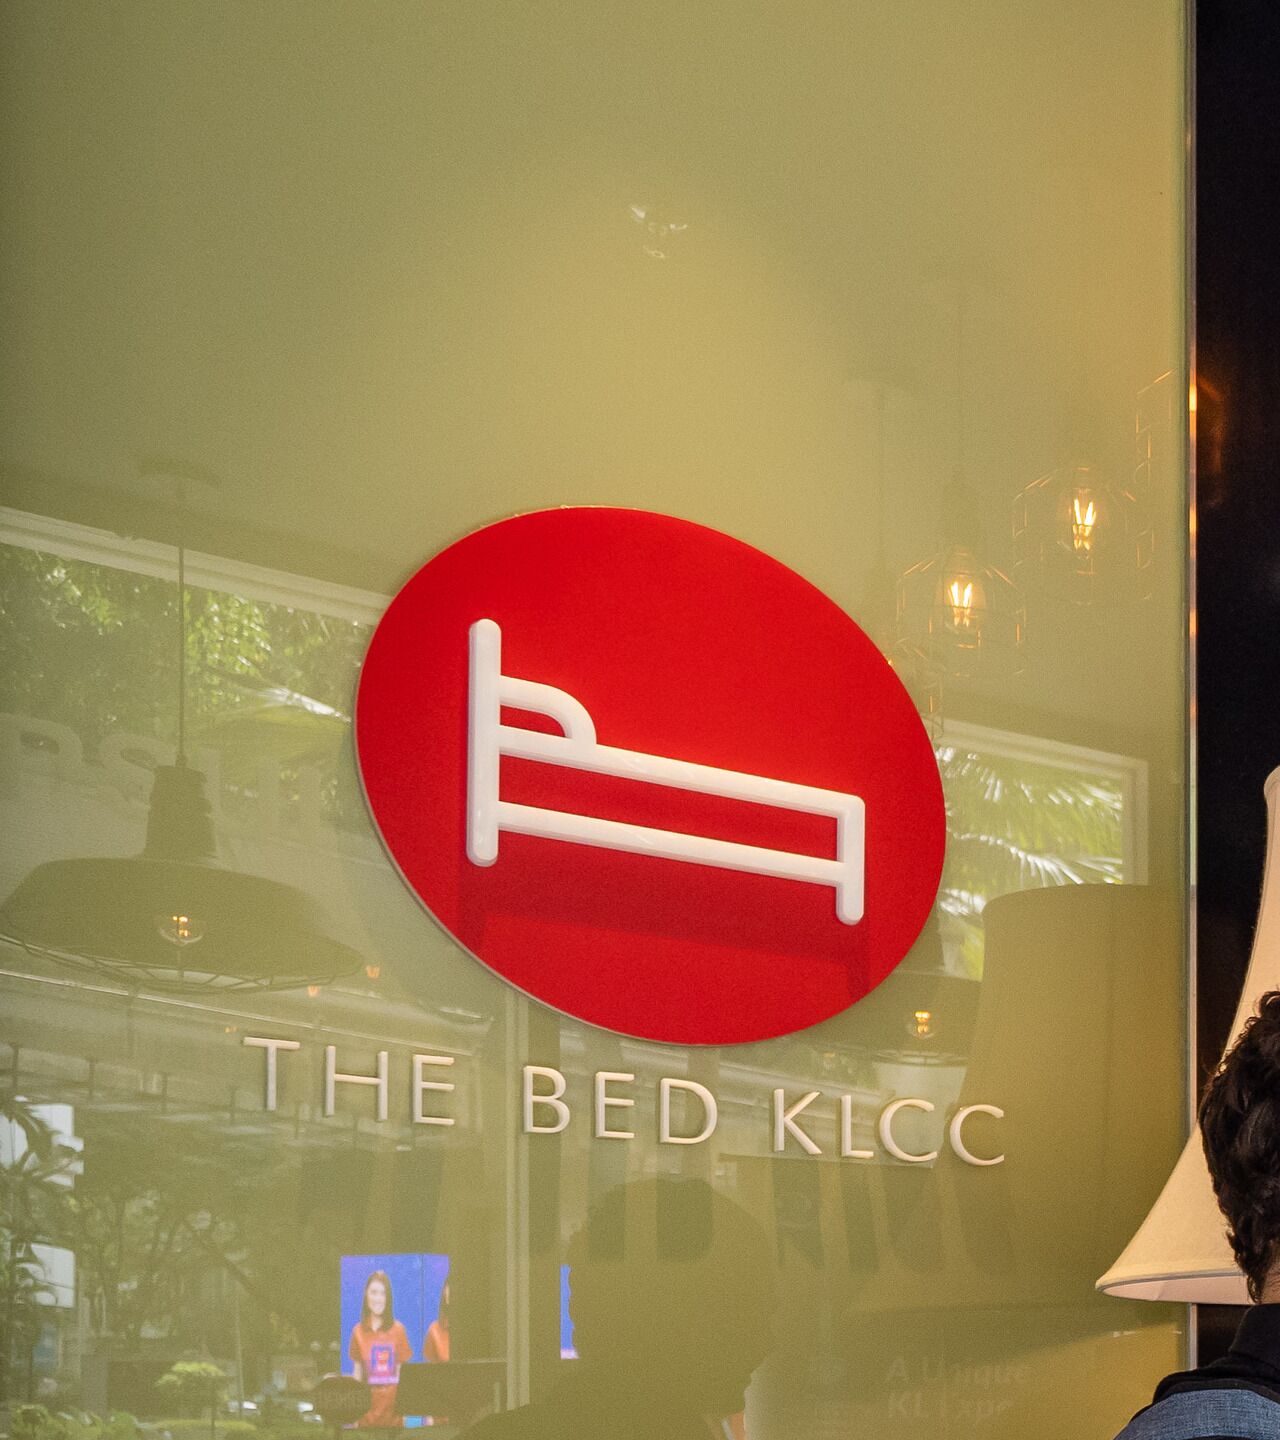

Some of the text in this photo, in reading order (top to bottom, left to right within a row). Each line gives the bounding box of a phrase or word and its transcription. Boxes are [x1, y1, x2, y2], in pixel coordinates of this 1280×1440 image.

[242, 1036, 1005, 1167] THE BED KLCC
